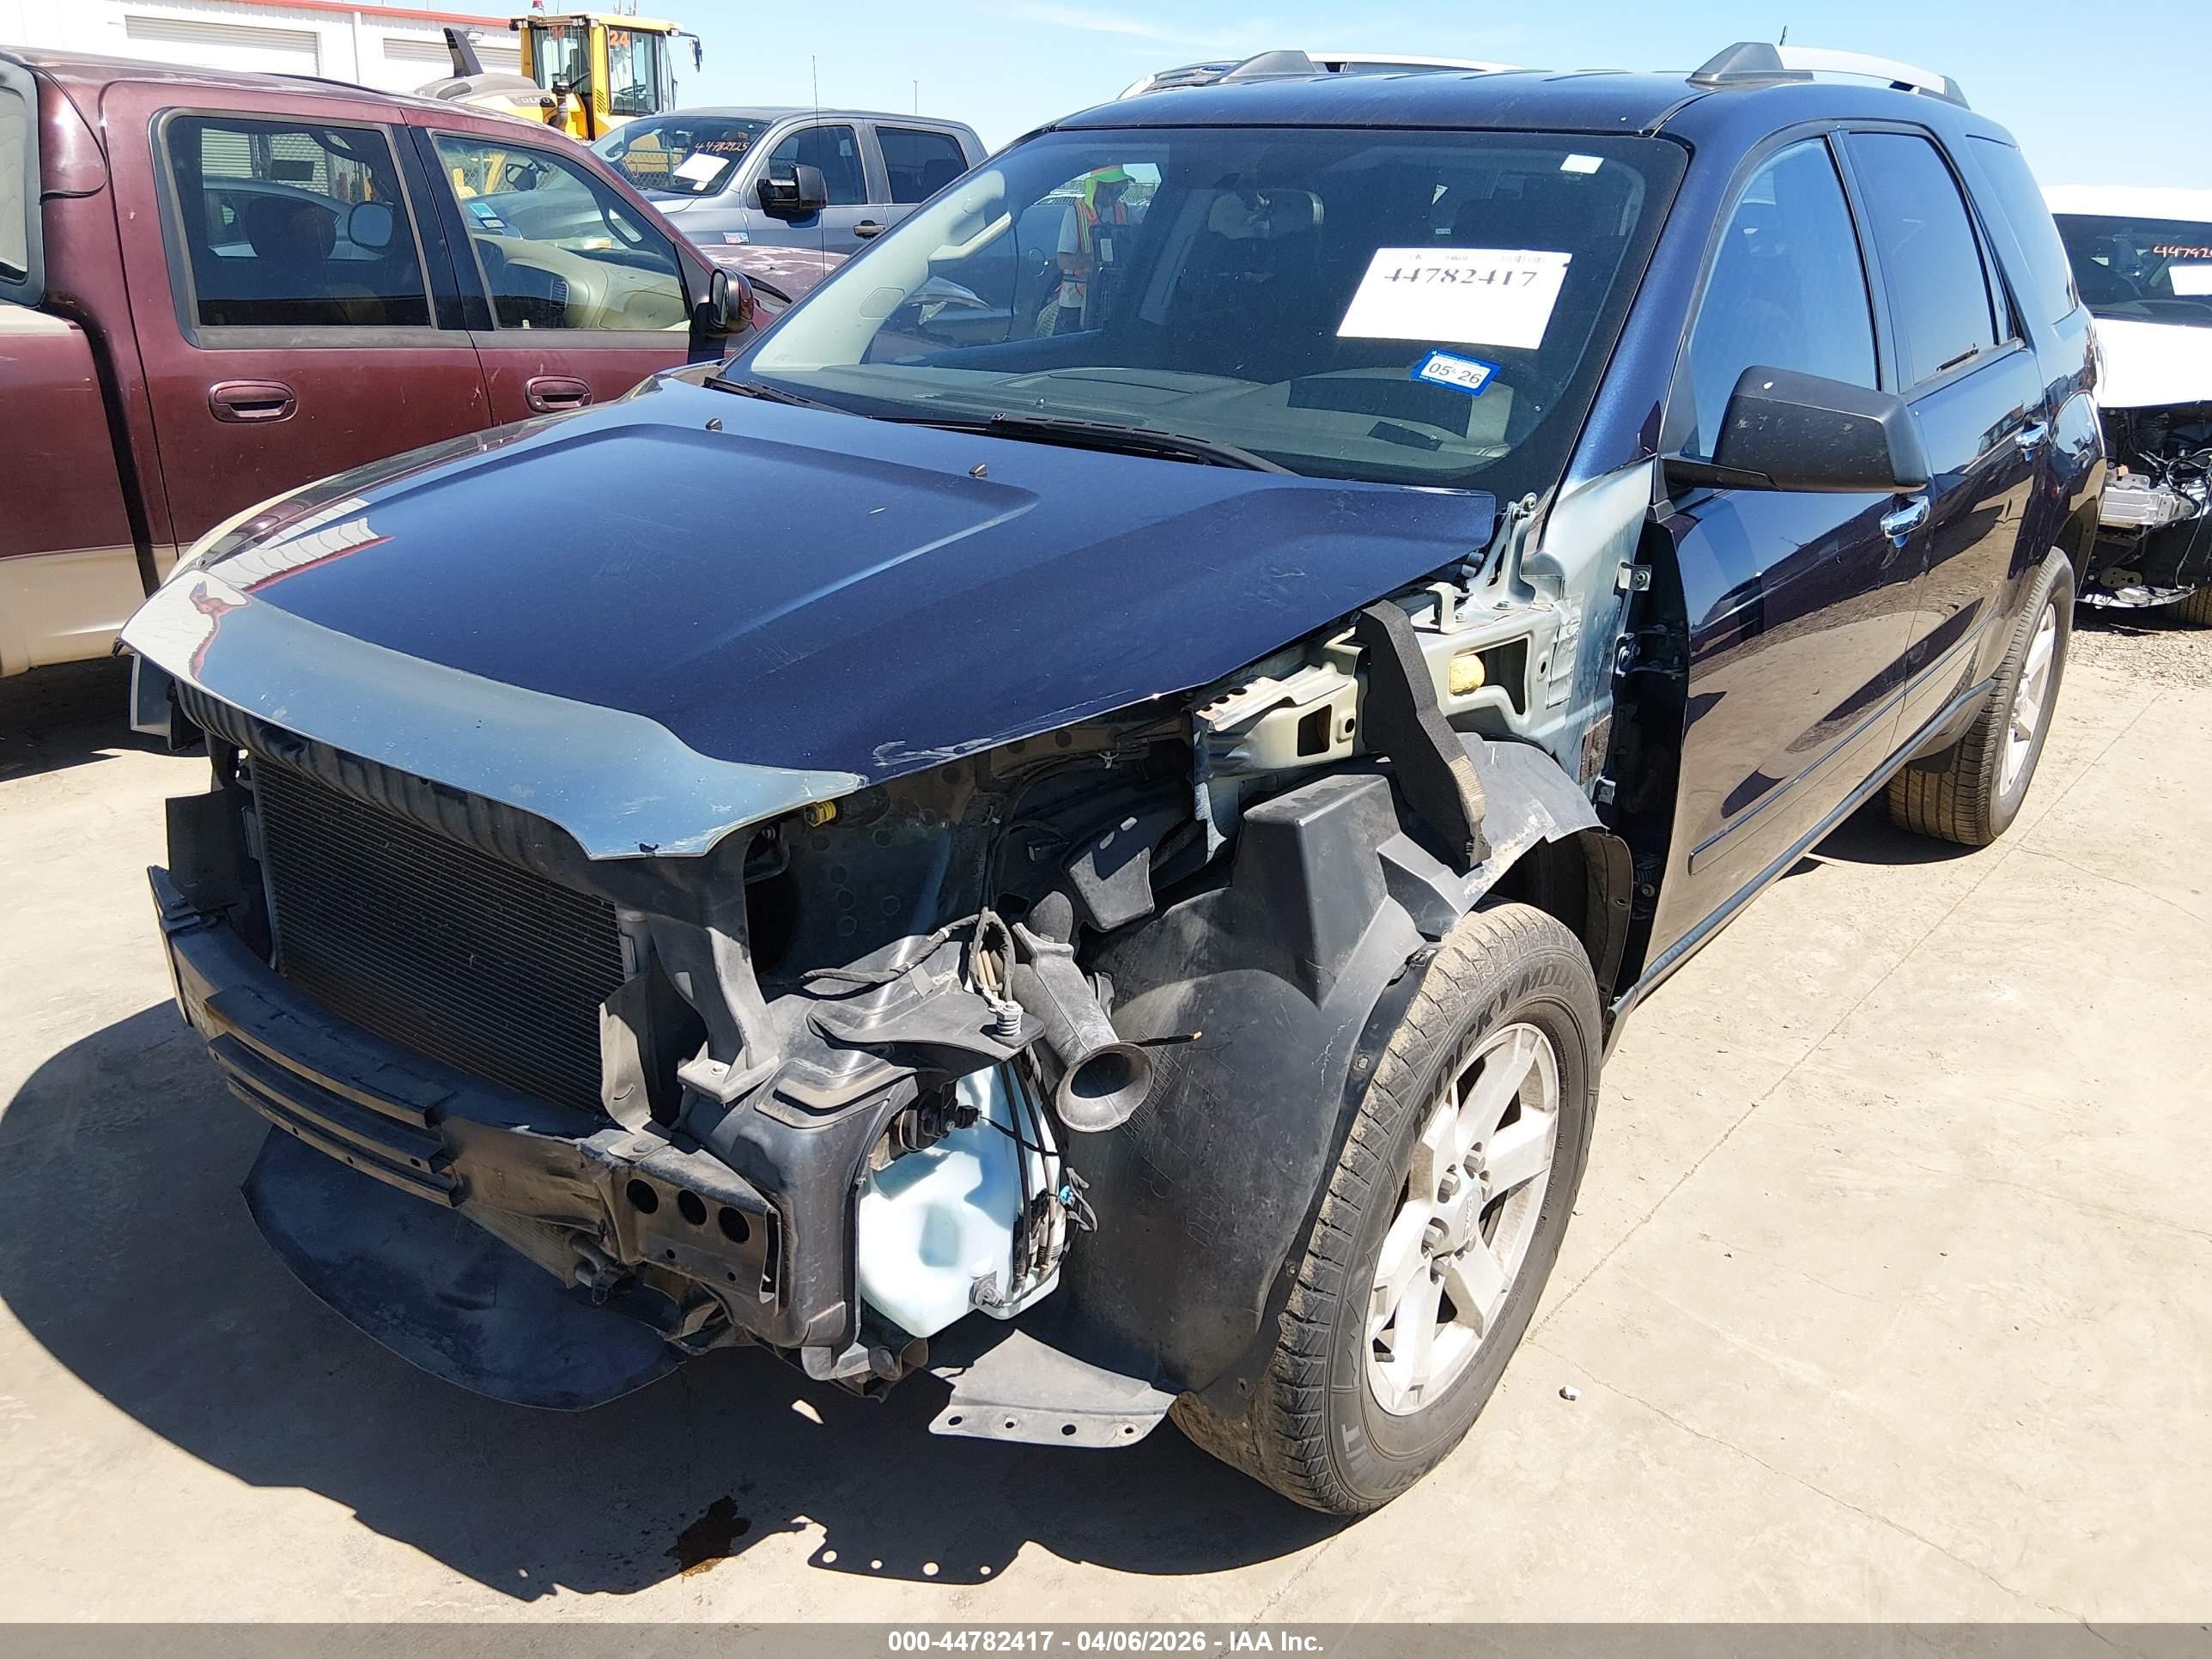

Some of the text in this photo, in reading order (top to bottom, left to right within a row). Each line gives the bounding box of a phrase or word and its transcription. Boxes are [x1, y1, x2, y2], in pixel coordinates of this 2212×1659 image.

[610, 30, 629, 46] 24
[2153, 246, 2212, 258] 44792
[1384, 268, 1537, 287] 44782417
[1428, 363, 1453, 376] 05
[1456, 370, 1482, 384] 26
